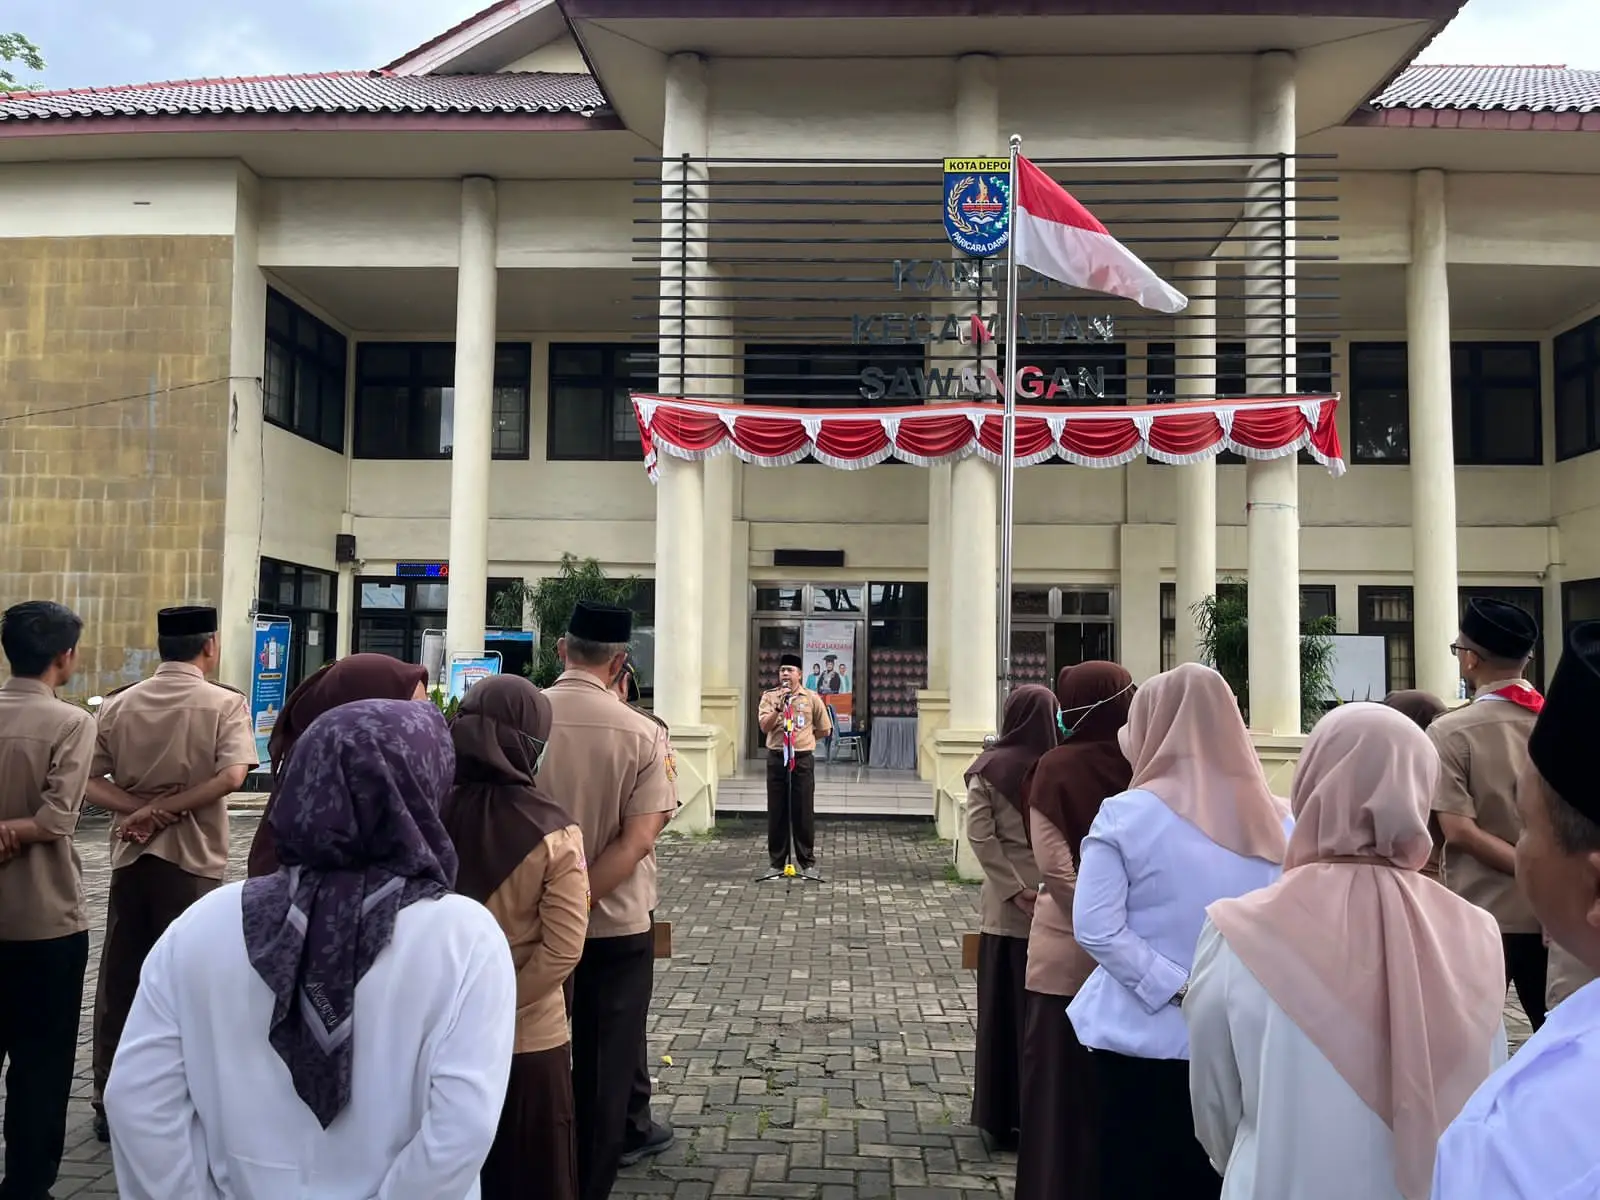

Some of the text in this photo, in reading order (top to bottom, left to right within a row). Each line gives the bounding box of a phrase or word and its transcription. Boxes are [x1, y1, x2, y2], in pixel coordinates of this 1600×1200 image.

[950, 162, 1010, 170] KOTA DEPO
[952, 231, 987, 252] PARICARA
[859, 366, 1105, 400] SAWANGAN
